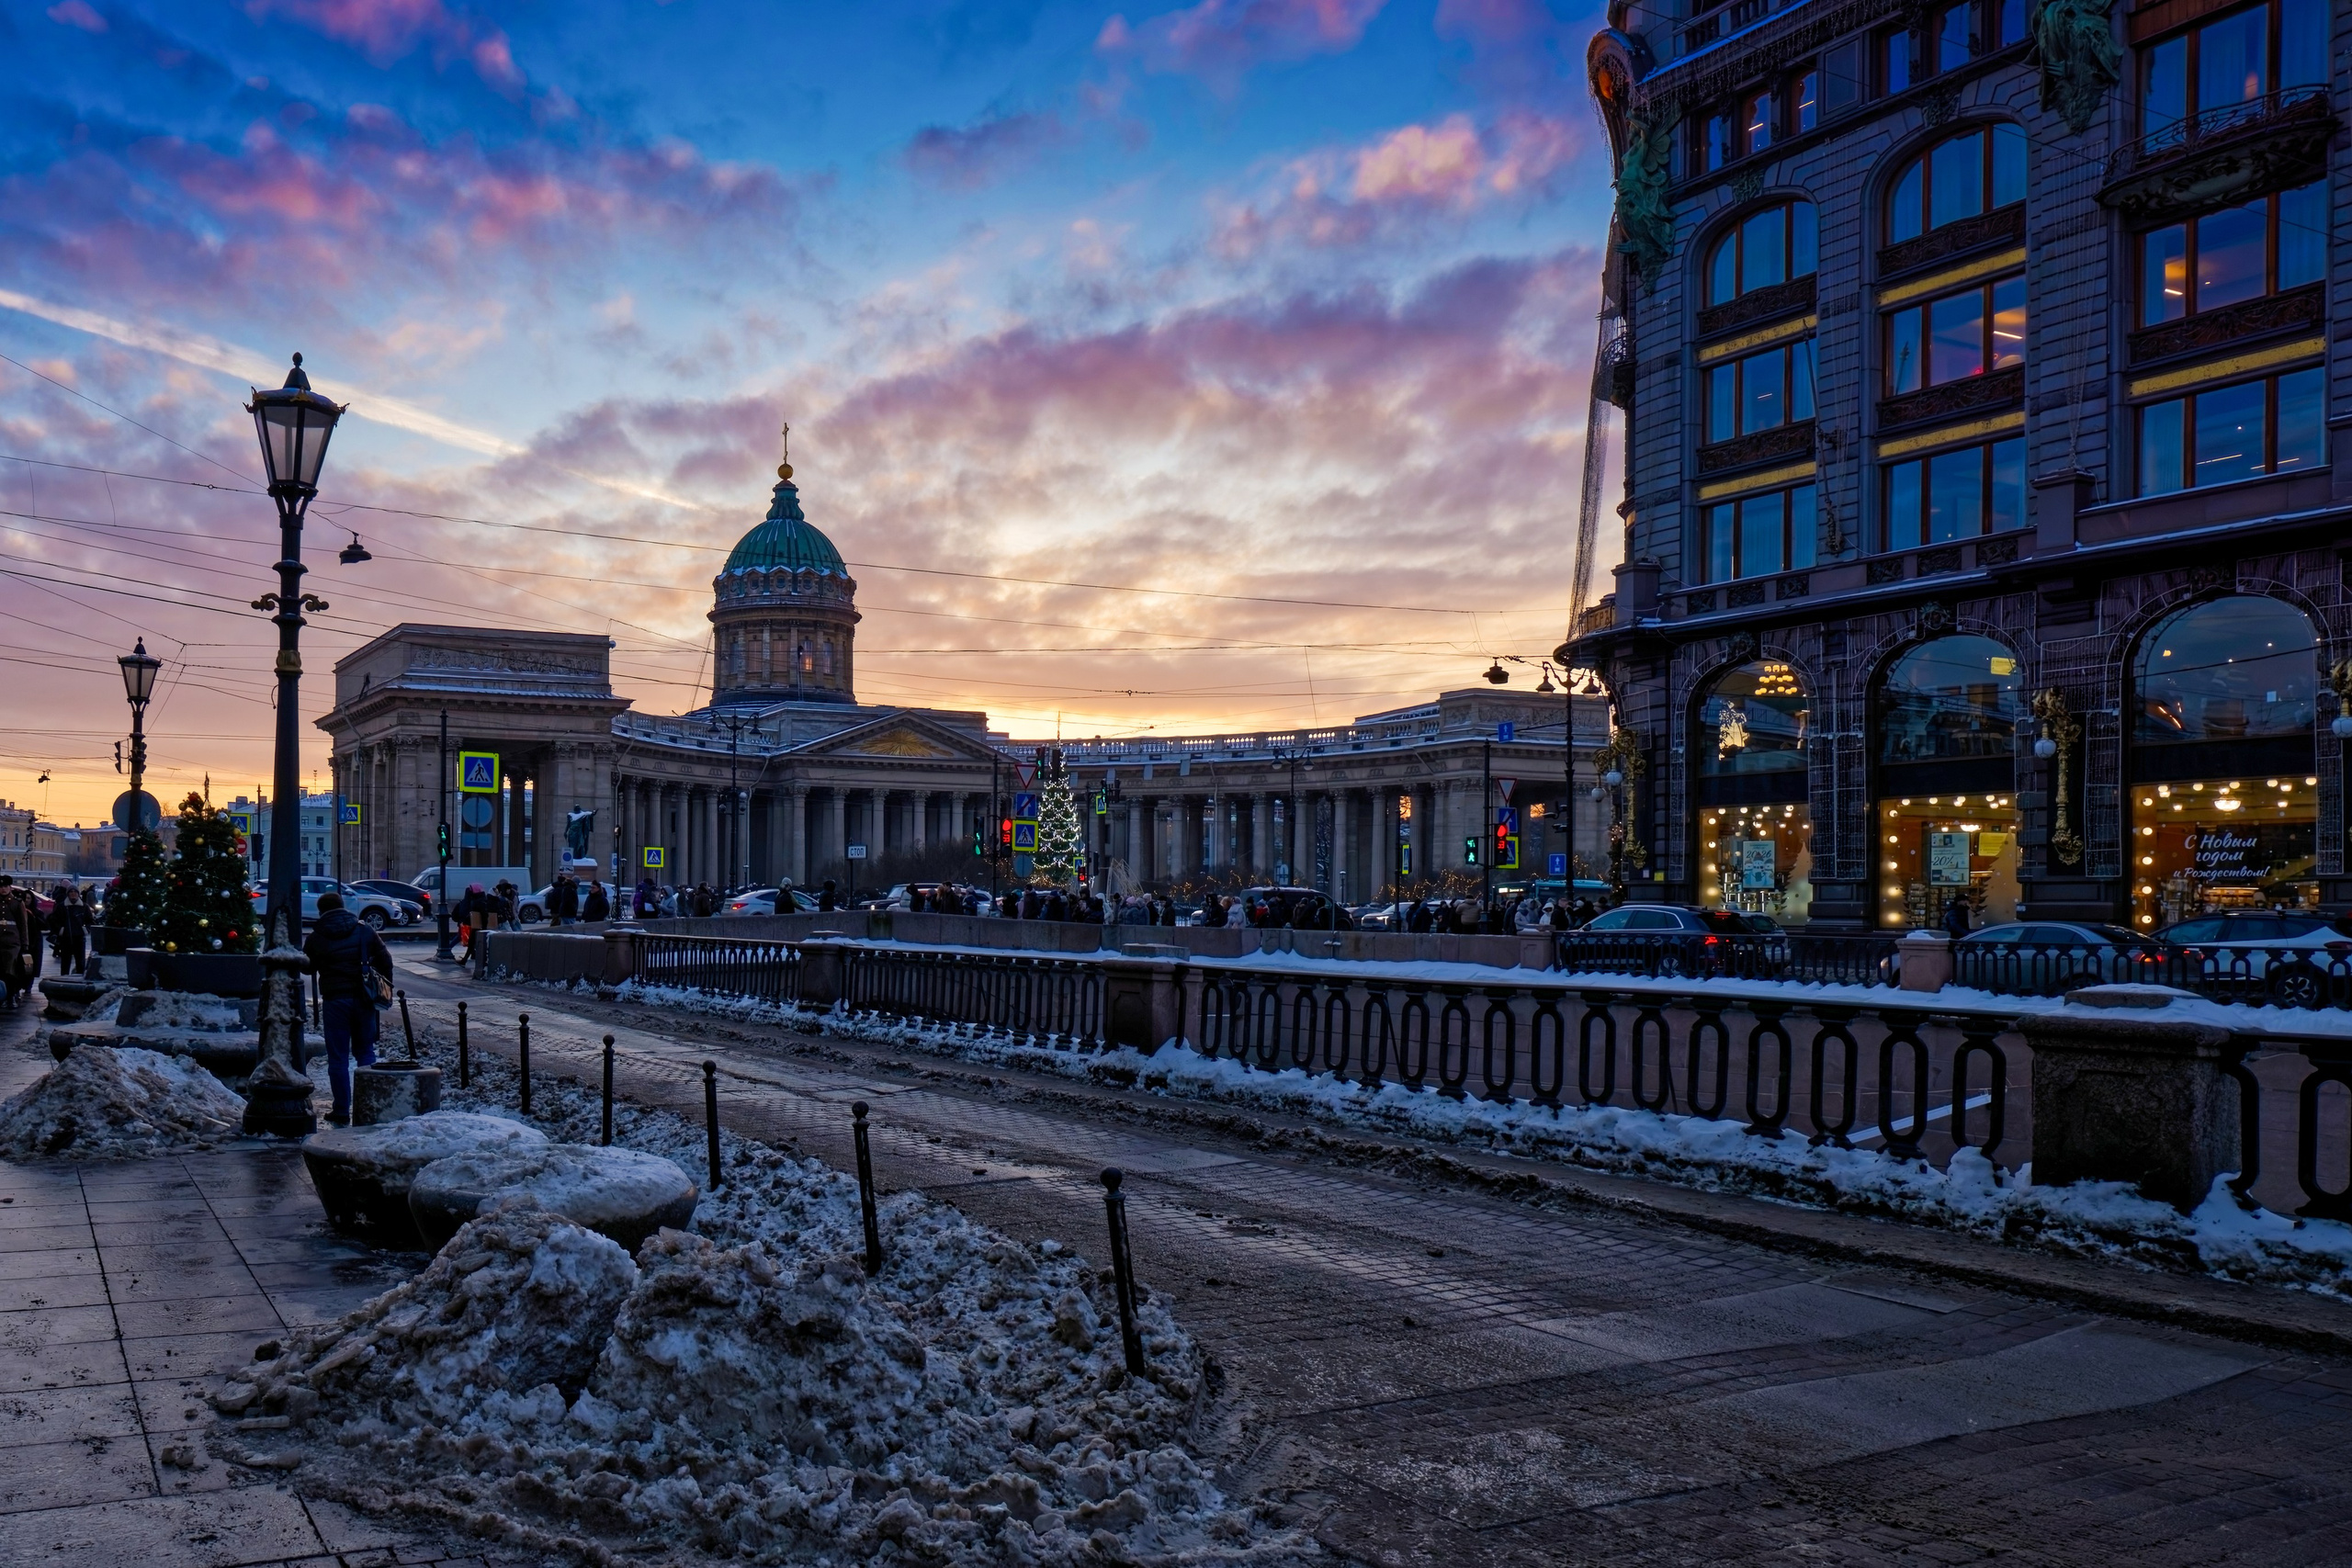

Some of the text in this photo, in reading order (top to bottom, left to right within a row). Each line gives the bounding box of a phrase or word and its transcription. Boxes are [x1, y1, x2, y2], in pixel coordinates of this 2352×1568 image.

[2184, 832, 2257, 850] С Новым
[850, 847, 865, 856] СТОП
[2195, 851, 2245, 867] годом
[2173, 865, 2271, 882] и Рождеством!
